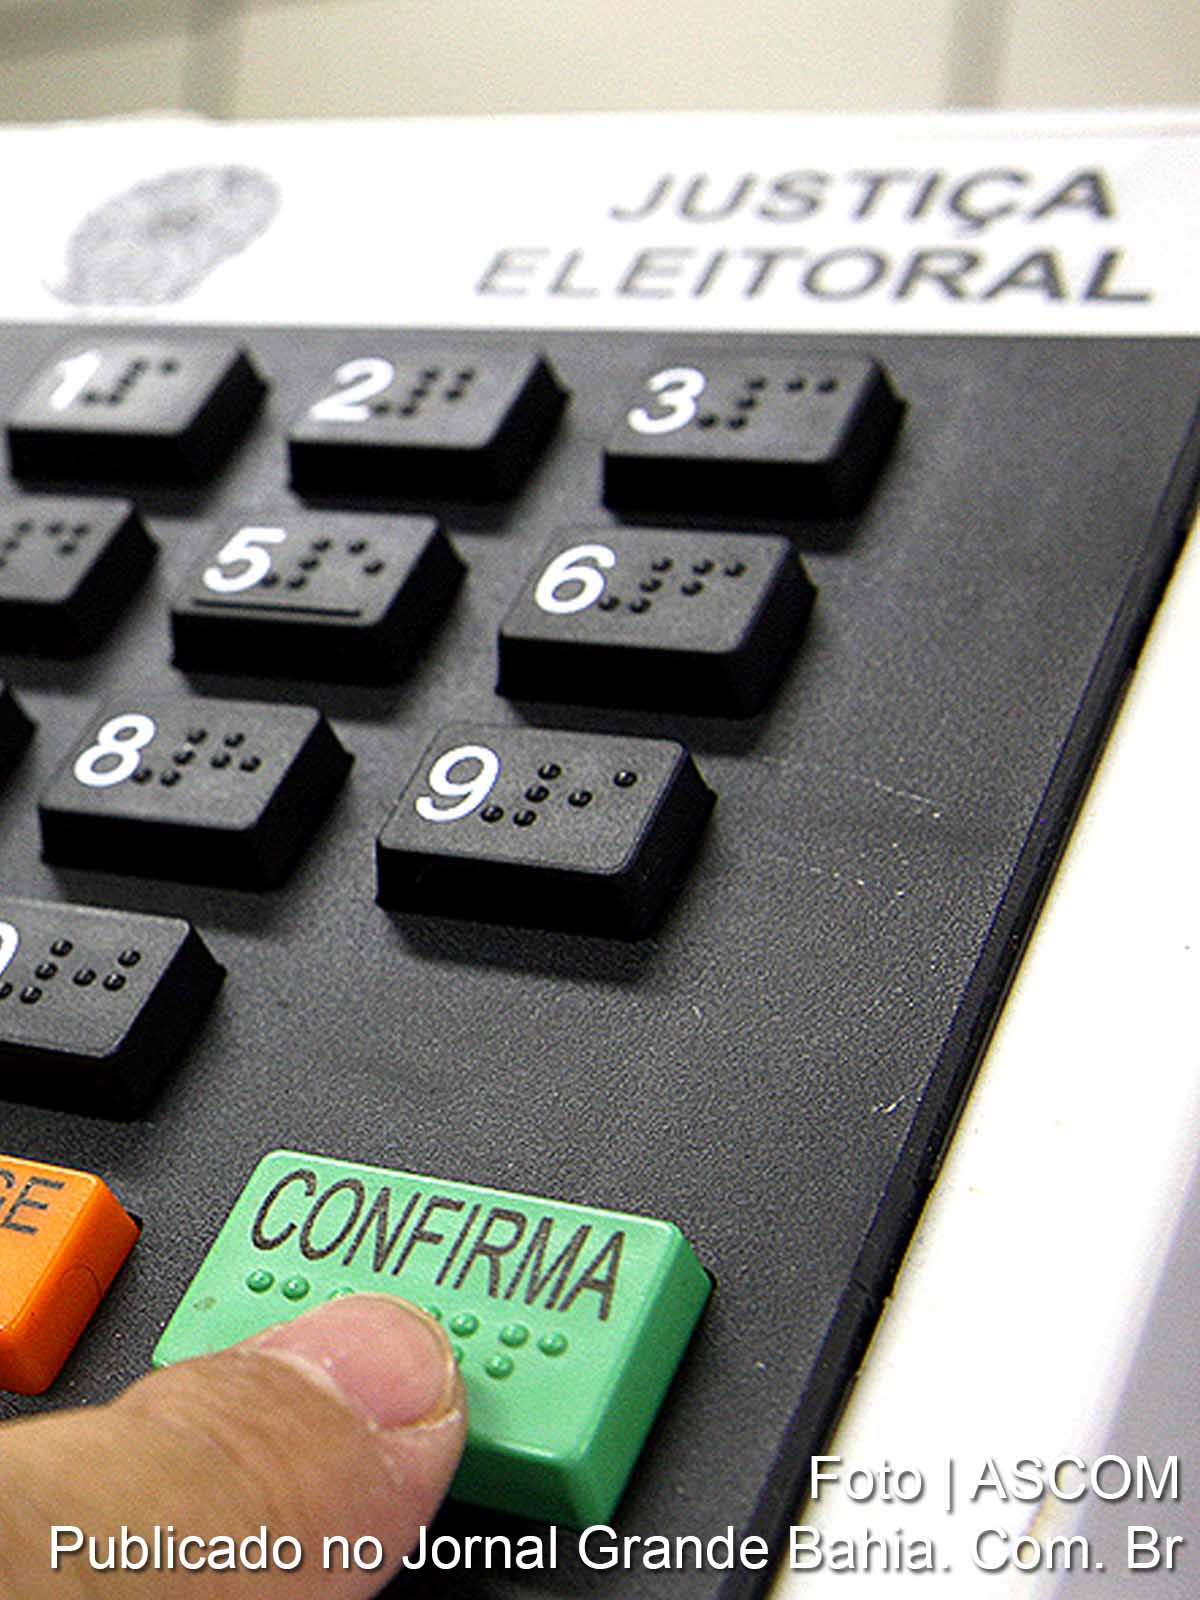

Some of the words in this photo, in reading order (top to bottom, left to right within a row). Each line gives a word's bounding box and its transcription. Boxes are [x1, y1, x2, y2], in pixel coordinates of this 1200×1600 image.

[610, 167, 1118, 230] JUSTIÇA
[474, 246, 1154, 304] ELEITORAL
[49, 350, 101, 410] 1
[308, 357, 395, 422] 2
[627, 367, 705, 435] 3
[203, 527, 287, 592] 5
[534, 543, 617, 614] 6
[73, 713, 157, 788] 8
[415, 744, 501, 823] 9
[250, 1168, 627, 1322] CONFIRMA
